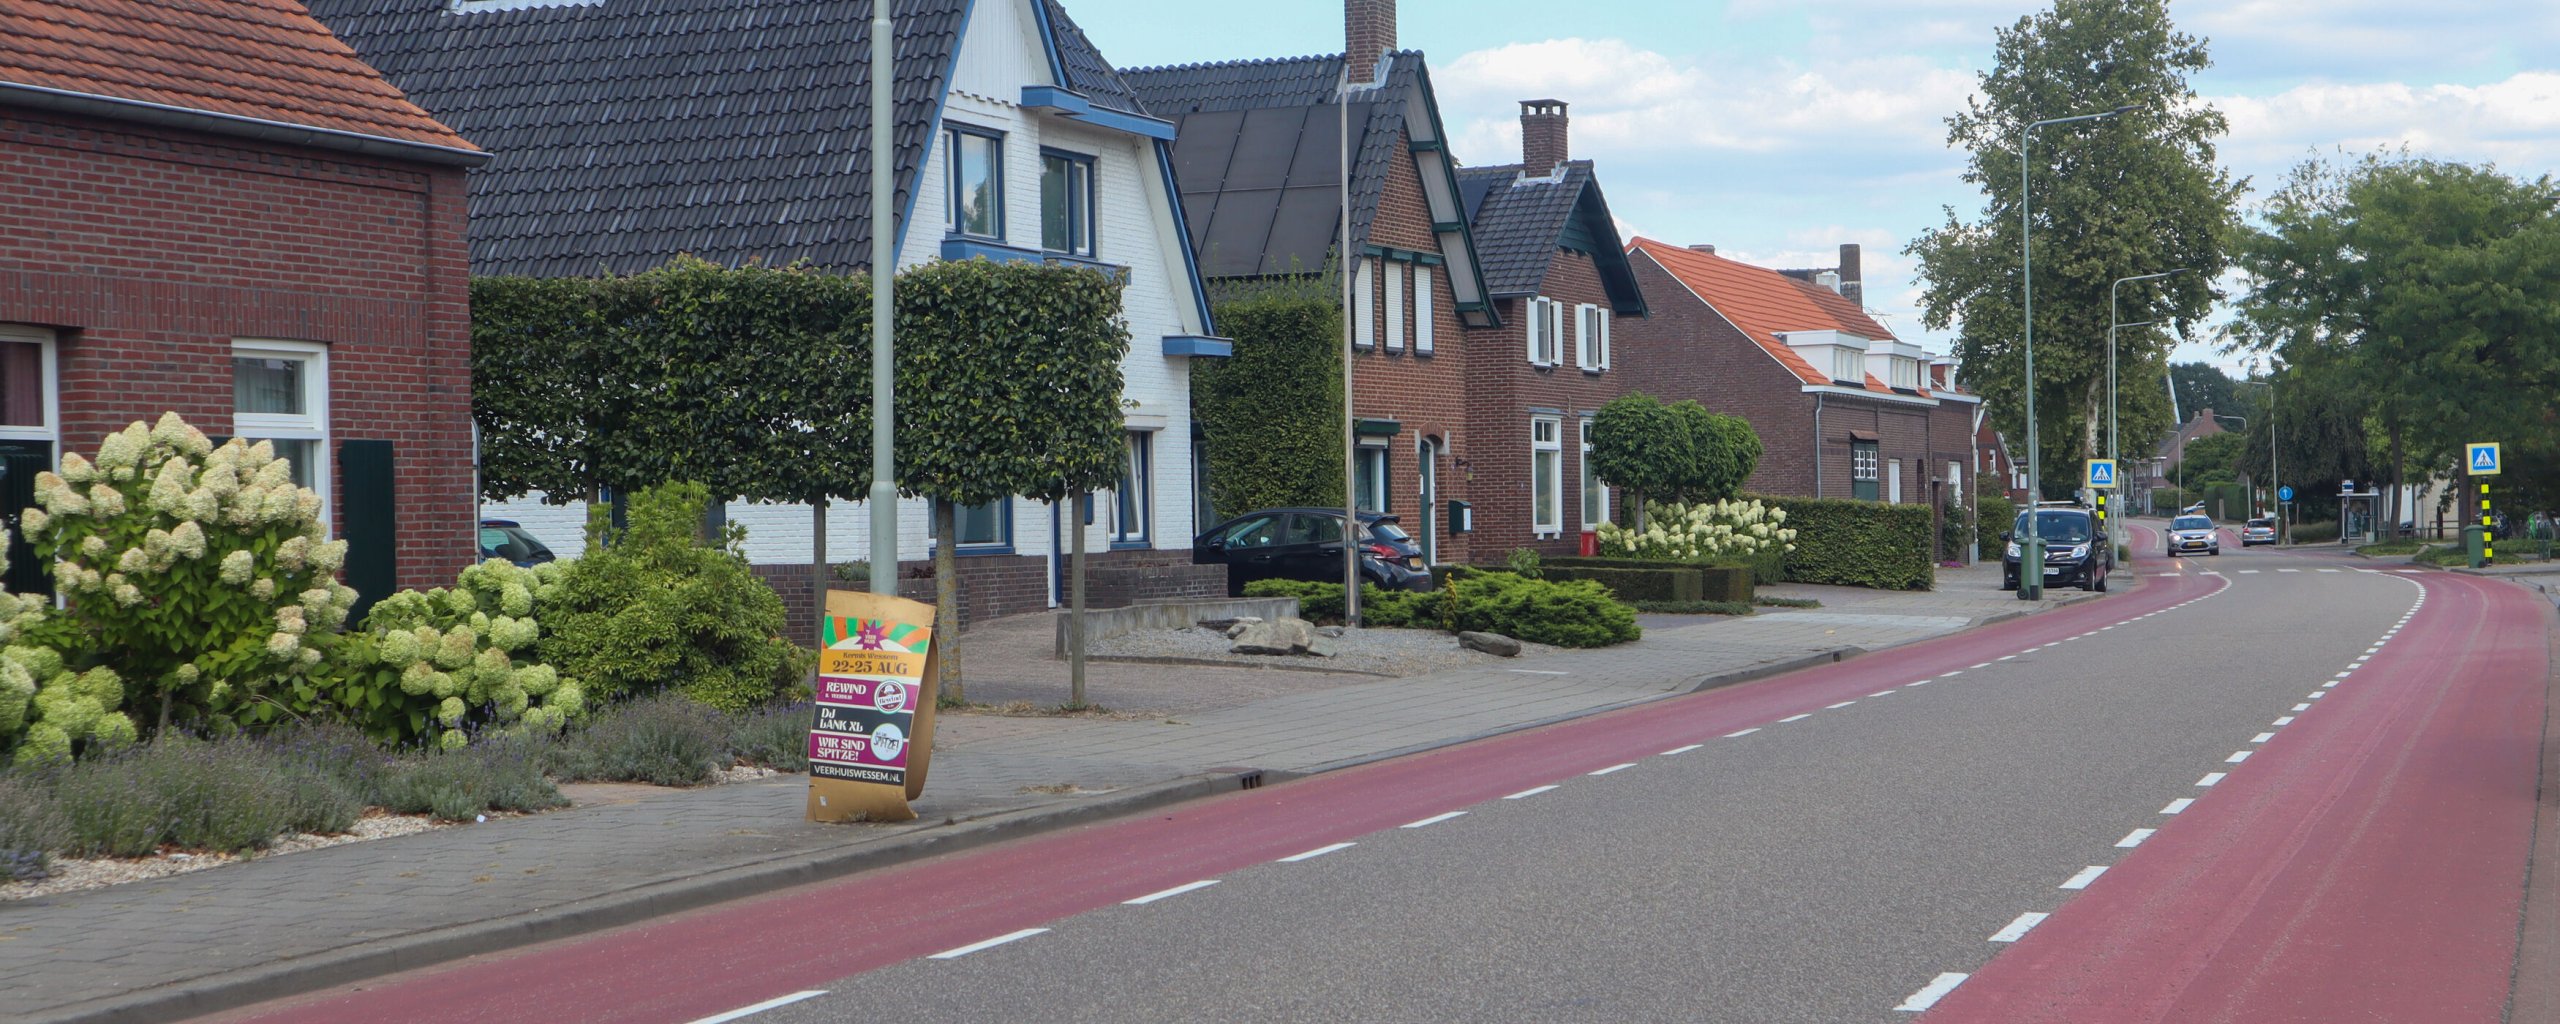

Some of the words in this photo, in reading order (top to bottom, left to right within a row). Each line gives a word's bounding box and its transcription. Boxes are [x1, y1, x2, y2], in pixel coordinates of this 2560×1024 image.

[843, 652, 866, 660] Kermis
[867, 653, 898, 661] Wessem
[832, 660, 873, 673] 22-25
[876, 662, 908, 675] AUG
[826, 681, 867, 695] REWIND
[821, 707, 836, 719] DJ
[819, 718, 847, 731] LANK
[849, 721, 864, 732] XL
[818, 736, 839, 748] WIR
[840, 738, 865, 751] SIND
[817, 747, 859, 761] SPITZE!
[813, 765, 901, 783] VEERHUISWESSEM.NL
